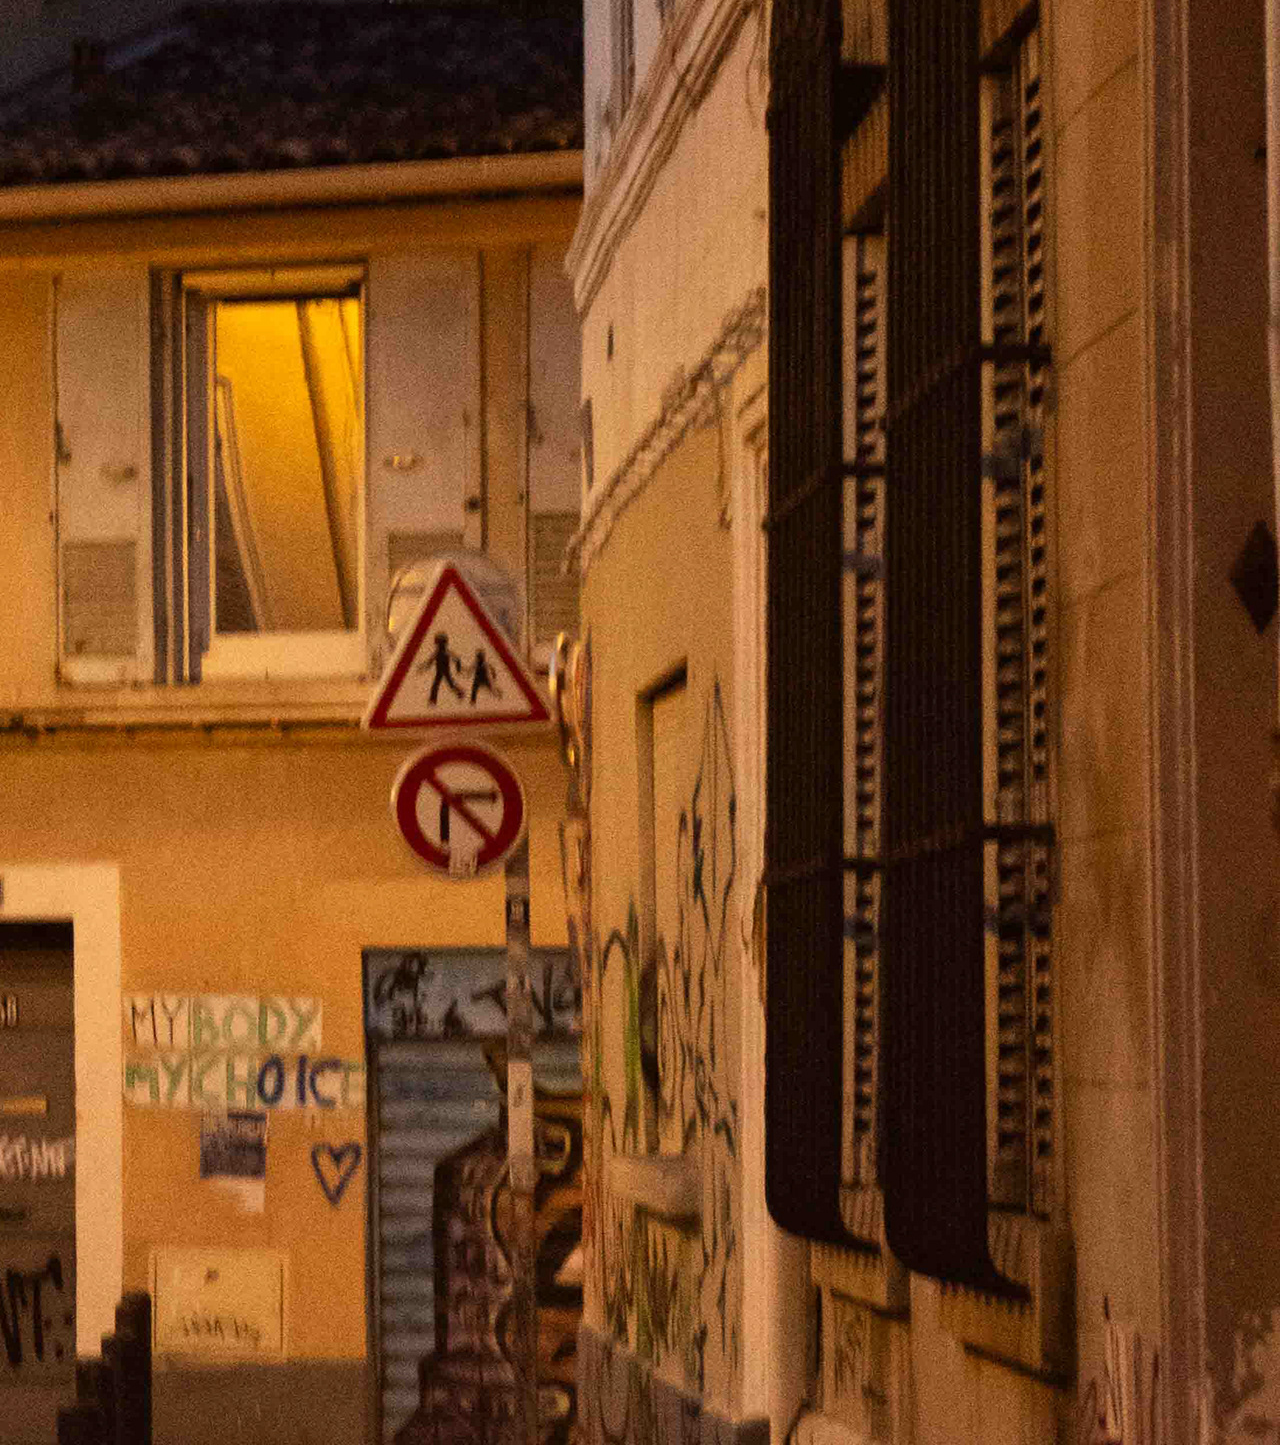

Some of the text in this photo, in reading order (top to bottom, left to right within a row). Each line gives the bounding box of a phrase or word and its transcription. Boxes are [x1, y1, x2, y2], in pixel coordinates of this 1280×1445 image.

[130, 998, 183, 1047] MY
[125, 1051, 367, 1109] MY CHOICE
